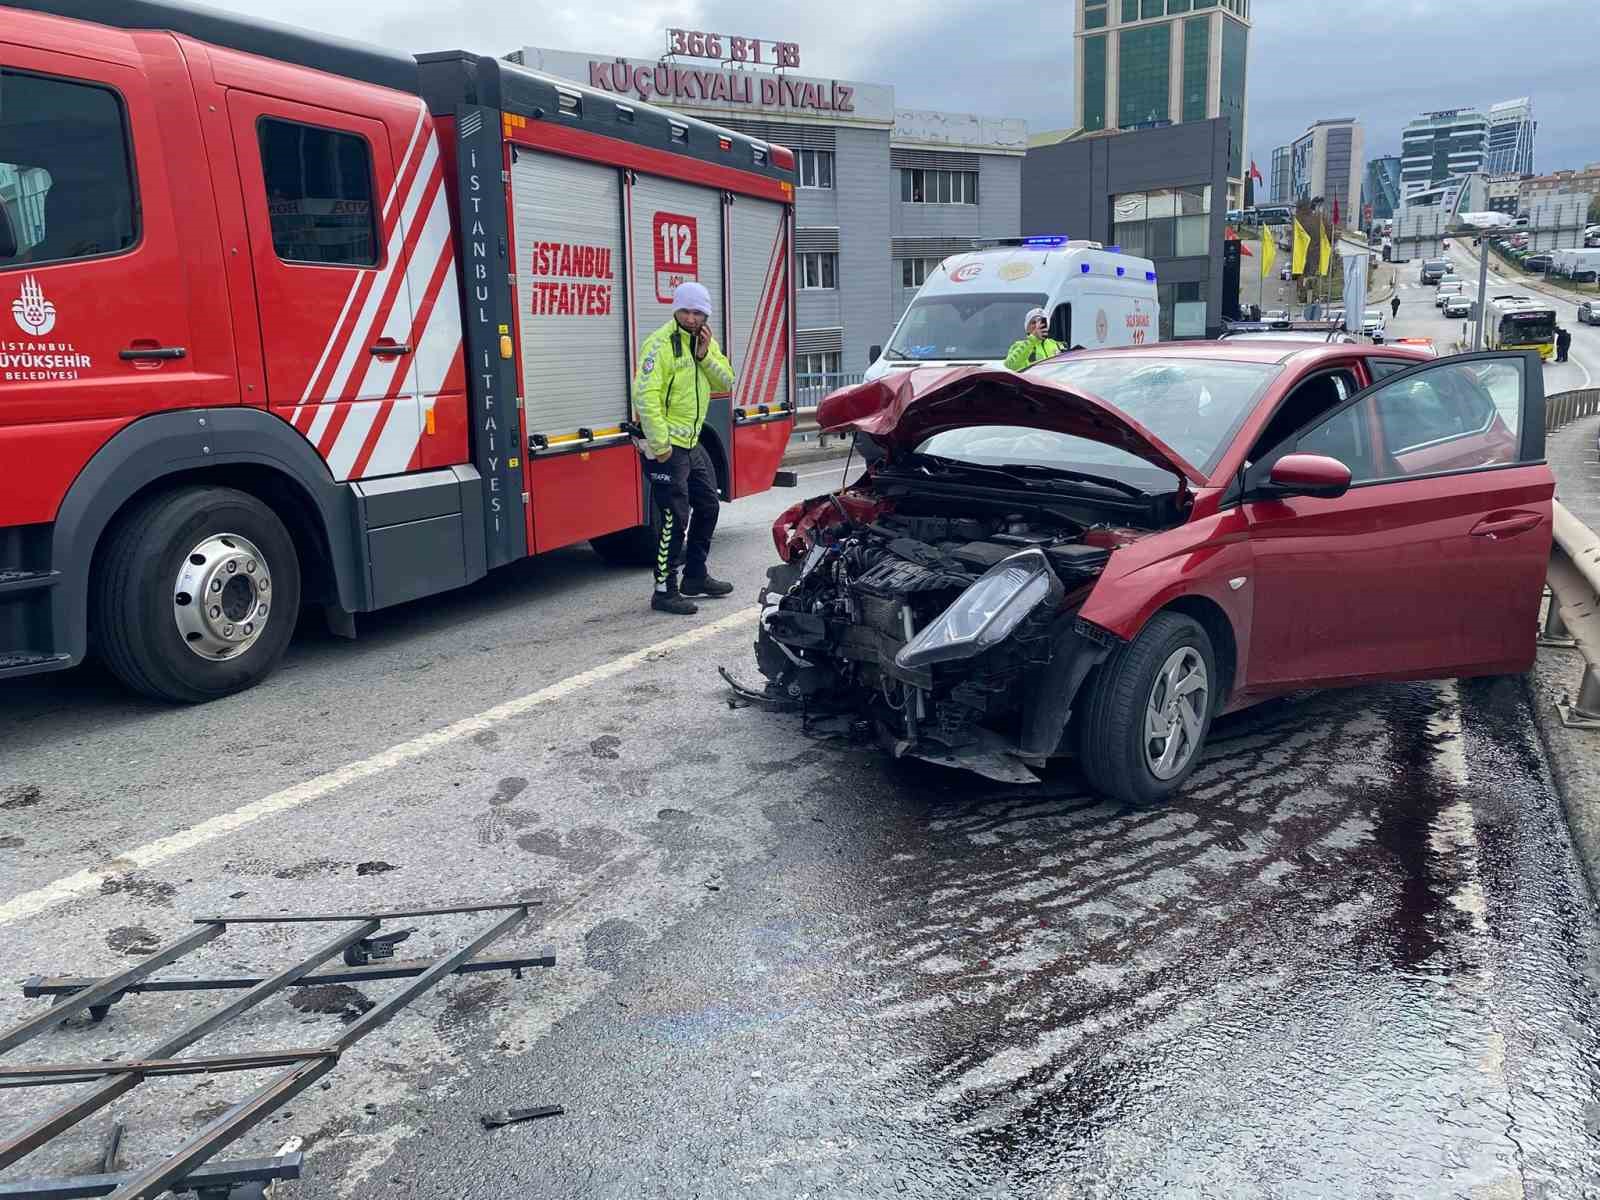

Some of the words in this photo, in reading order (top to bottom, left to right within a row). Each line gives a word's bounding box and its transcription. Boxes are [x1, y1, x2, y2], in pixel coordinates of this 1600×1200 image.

[672, 29, 722, 58] 366
[731, 36, 761, 63] 81
[772, 40, 801, 68] 18
[588, 56, 753, 103] KÜÇÜKYALI
[760, 74, 856, 112] DİYALİZ
[661, 222, 693, 265] 112
[1, 341, 75, 352] İSTANBUL
[5, 369, 78, 380] BELEDİYESİ
